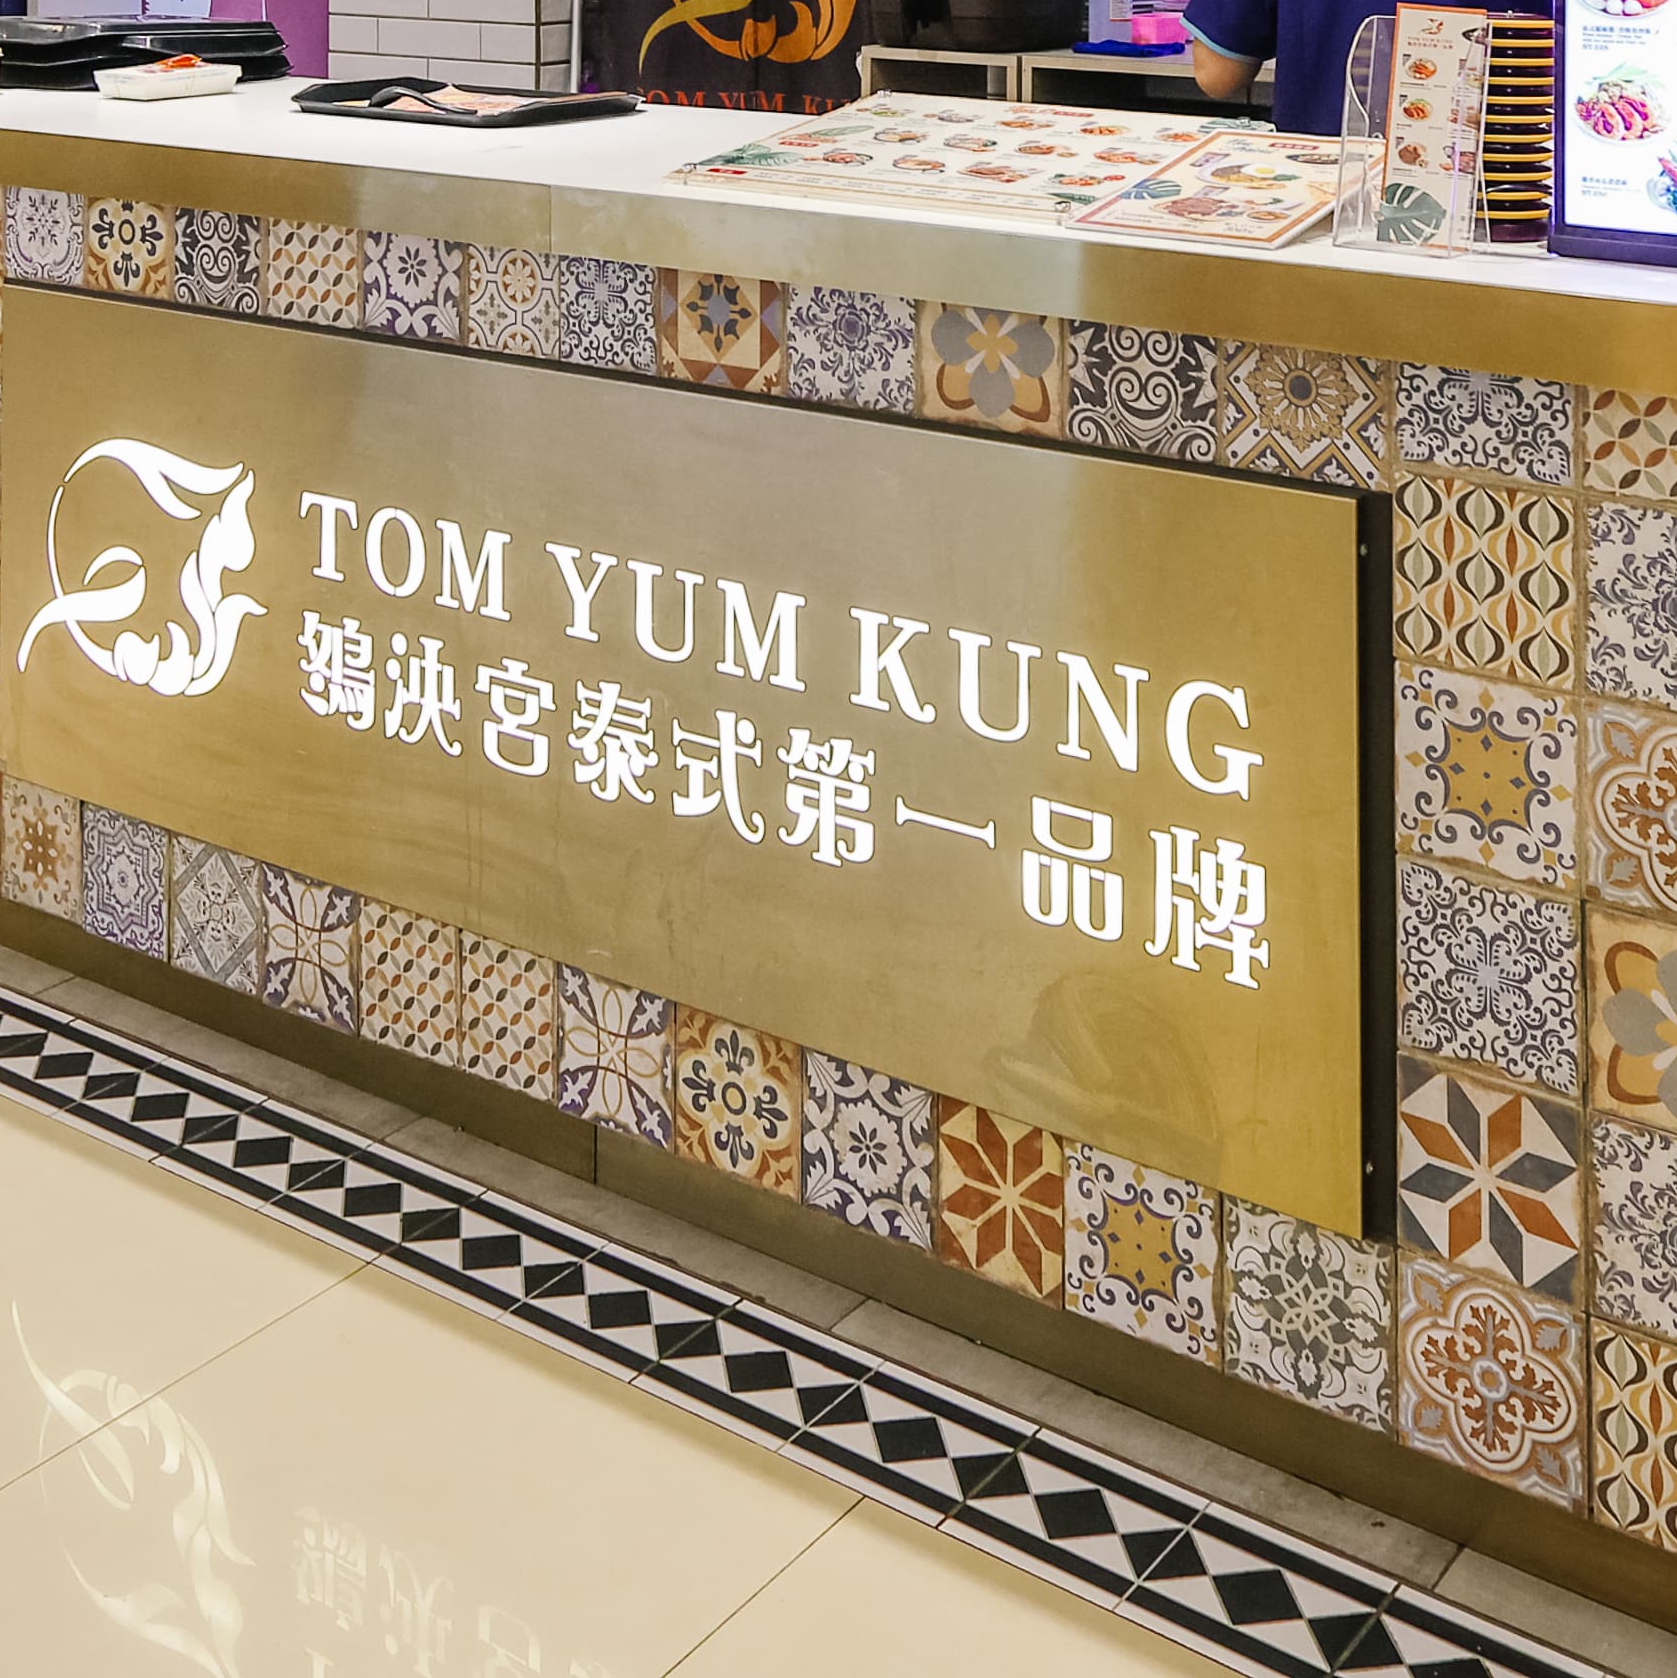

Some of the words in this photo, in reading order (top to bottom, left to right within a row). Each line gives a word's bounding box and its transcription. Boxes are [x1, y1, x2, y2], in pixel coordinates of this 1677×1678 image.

[296, 486, 513, 622] TOM
[542, 538, 811, 696] YUM
[847, 604, 1267, 805] KUNG
